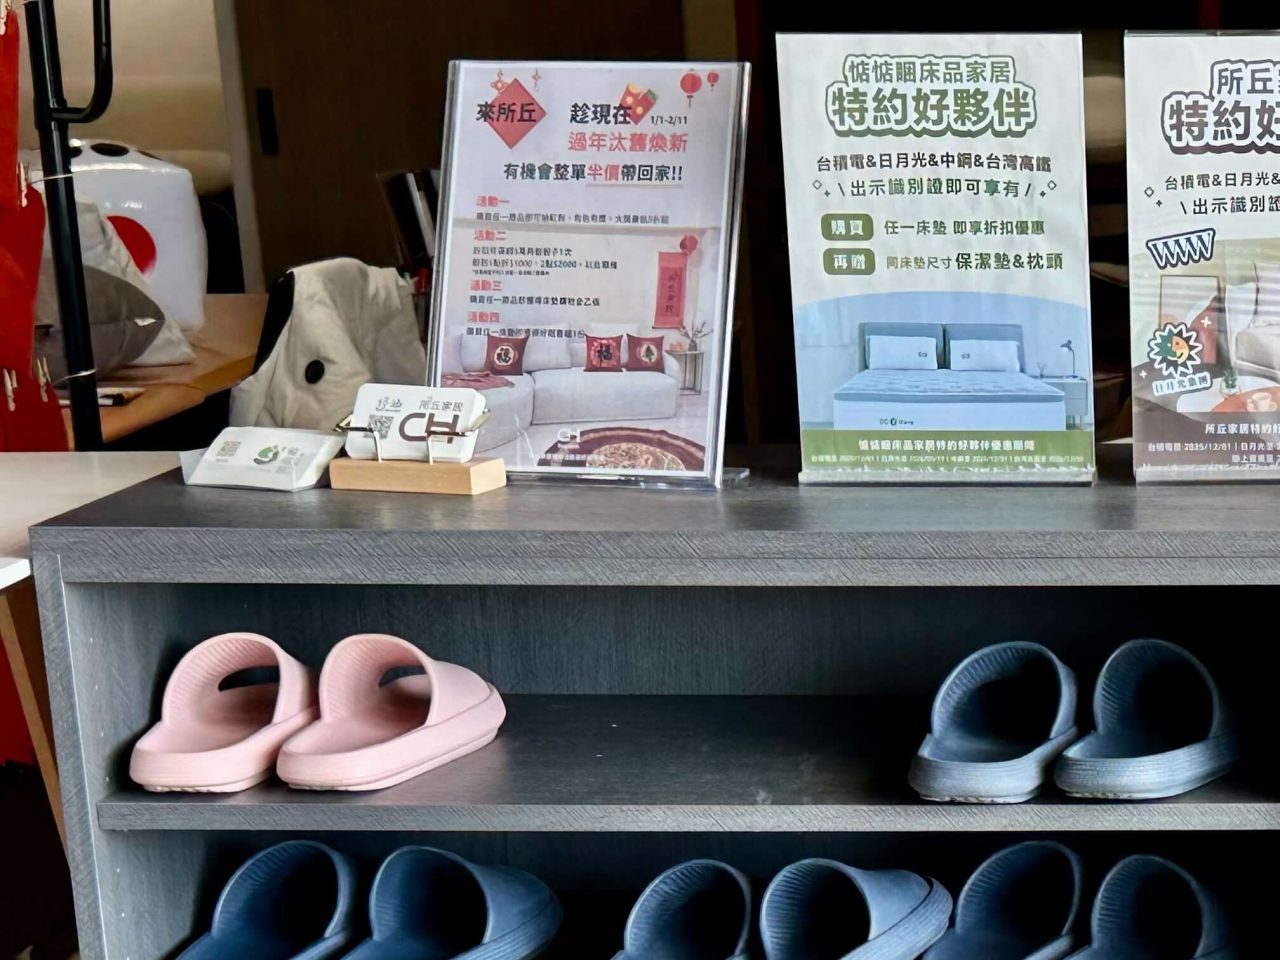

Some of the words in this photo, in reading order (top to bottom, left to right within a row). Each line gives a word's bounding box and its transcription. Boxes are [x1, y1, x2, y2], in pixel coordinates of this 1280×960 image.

[848, 59, 1011, 85] 惦惦睏床品家居
[475, 102, 538, 124] 來所丘
[569, 102, 634, 125] 趁現在
[650, 115, 688, 126] 1/1-2/11
[831, 86, 1032, 128] 特約好夥伴
[503, 162, 683, 182] 有機會整單半價帶回家!!
[816, 152, 1052, 173] 台積電&日月光&中鋼&台灣高鐵
[850, 177, 1020, 198] 出示識別證即可享有
[830, 219, 865, 236] 購買
[883, 219, 948, 236] 任一床墊
[953, 219, 1046, 236] 即享折扣優惠
[832, 253, 867, 270] 再贈
[399, 412, 460, 444] CH
